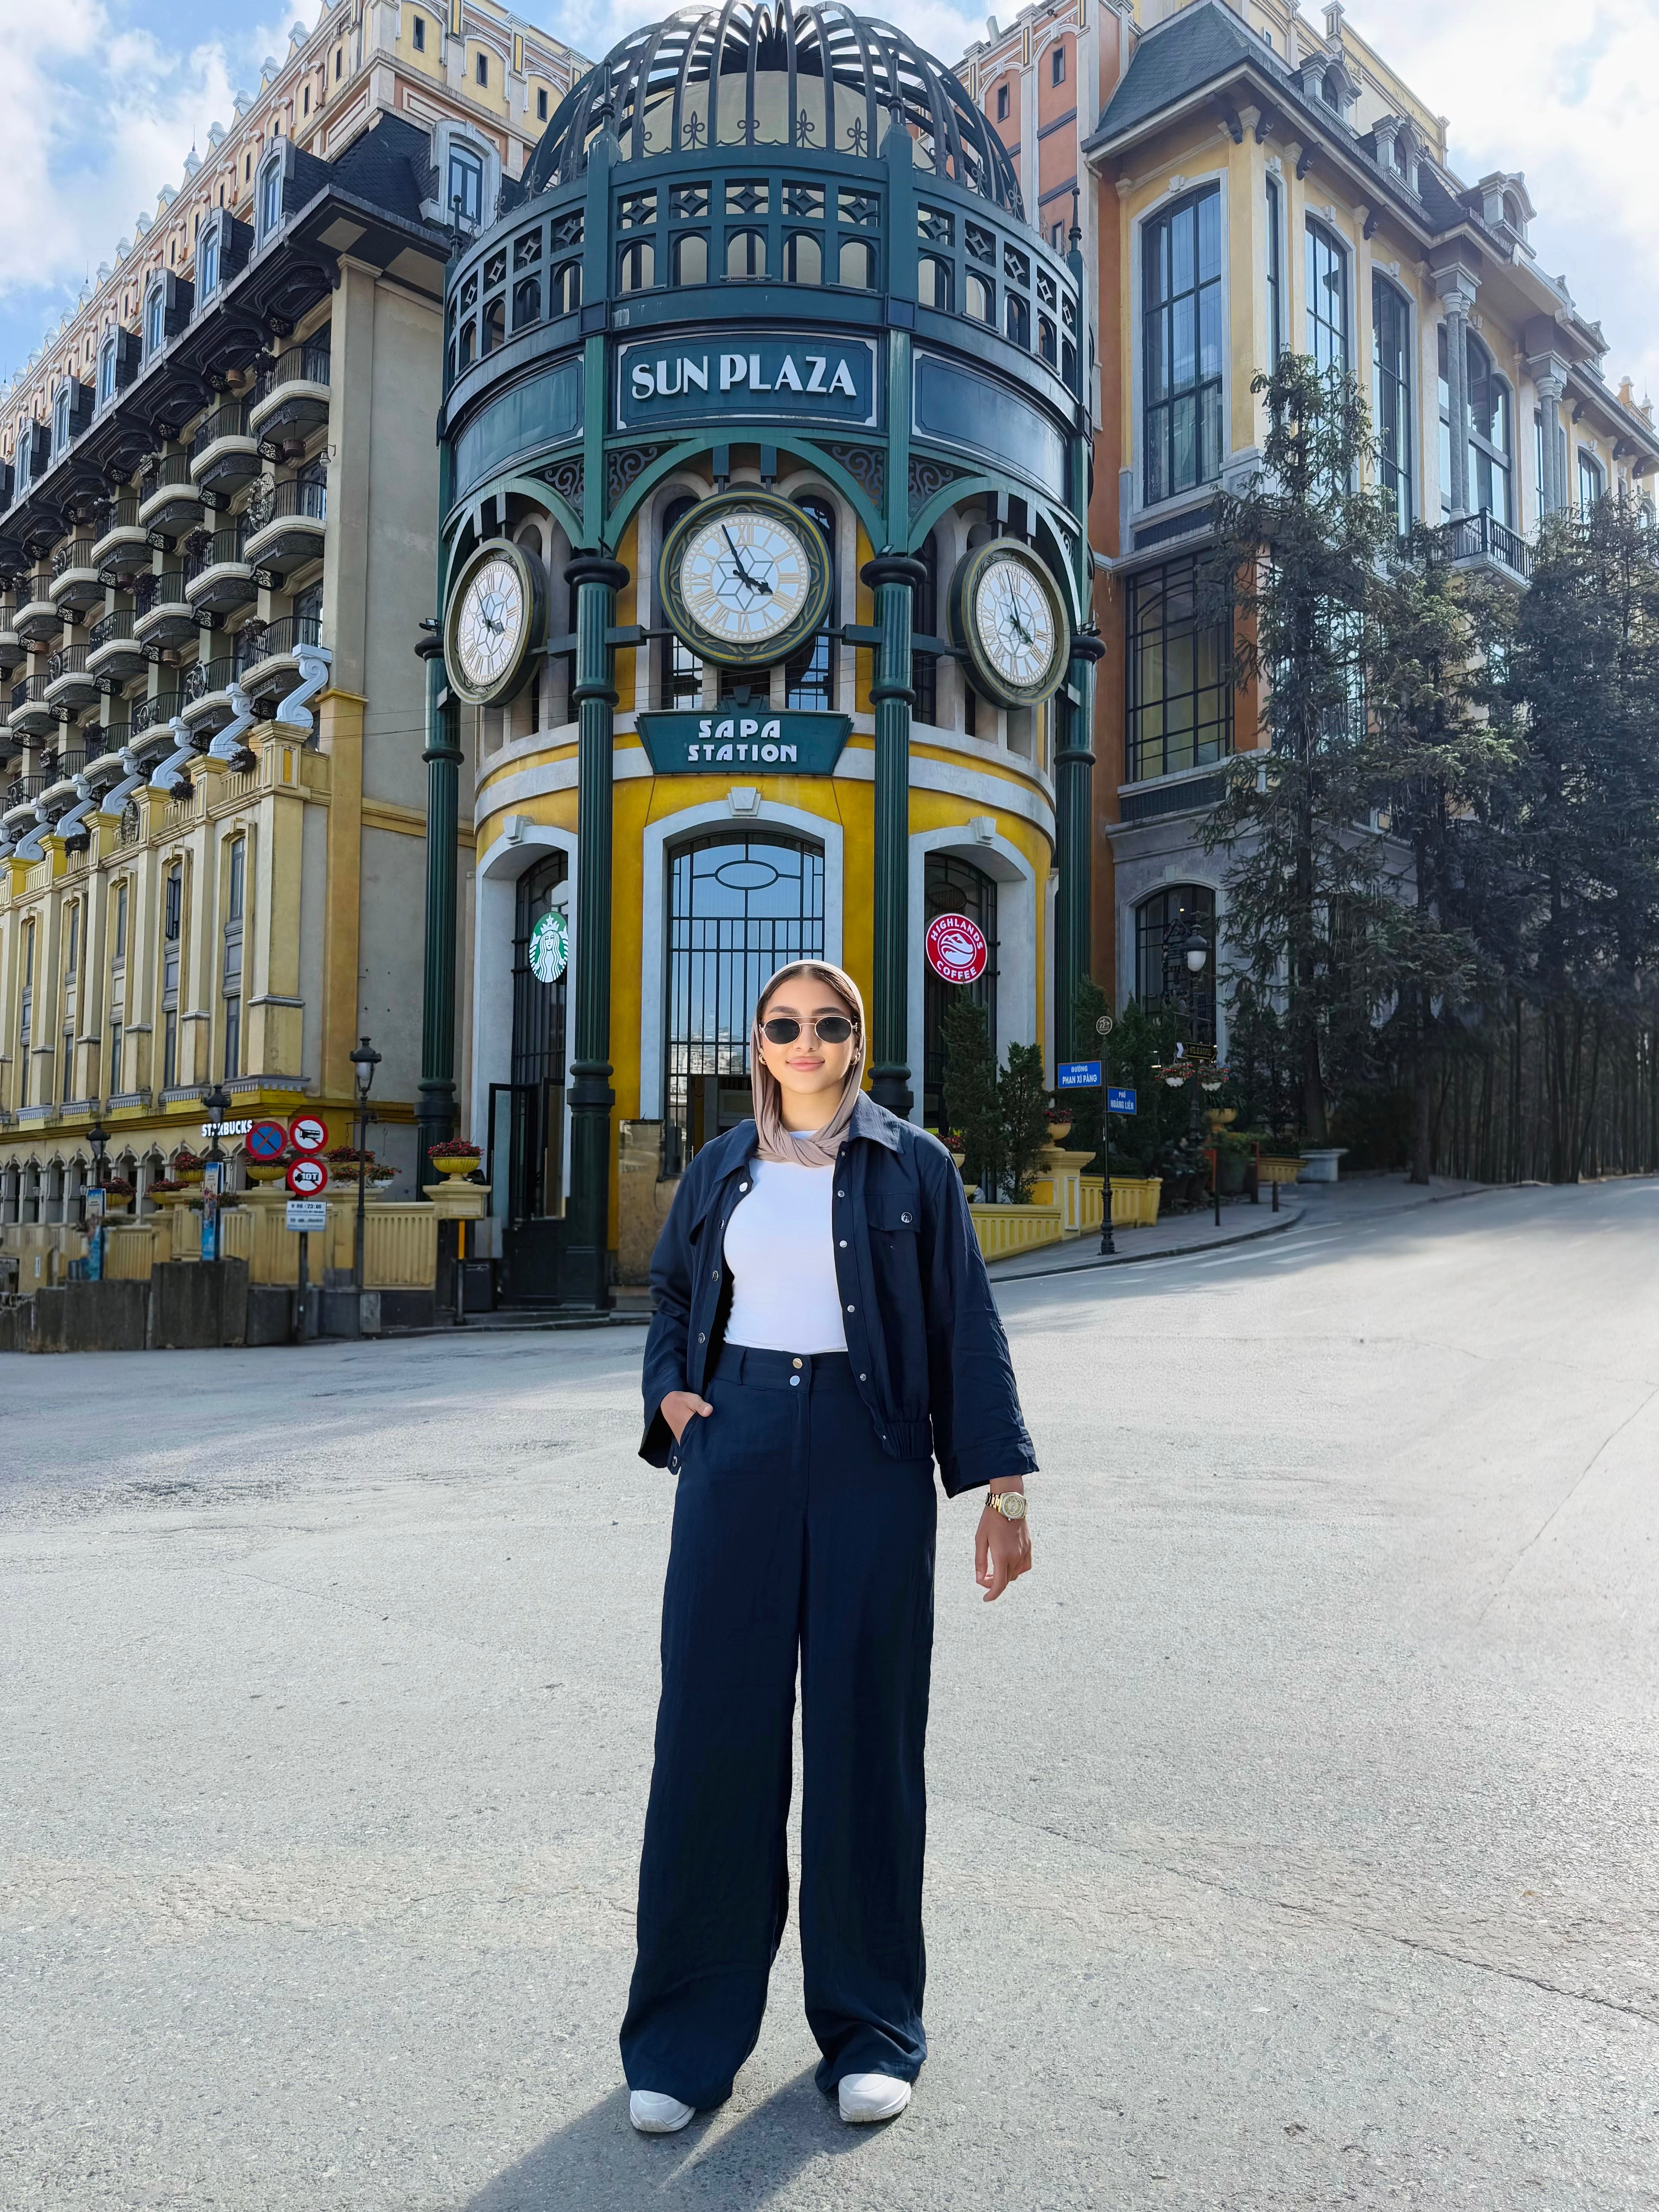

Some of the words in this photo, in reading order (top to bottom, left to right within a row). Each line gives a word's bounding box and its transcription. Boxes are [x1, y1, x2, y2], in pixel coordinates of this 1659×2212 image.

[632, 355, 708, 400] SUN
[720, 354, 857, 397] PLAZA
[699, 719, 780, 738] SAPA
[688, 744, 797, 762] STATION
[931, 918, 983, 950] HIGHLANDS
[937, 960, 977, 980] COFFEE
[1062, 1076, 1076, 1084] PHAN
